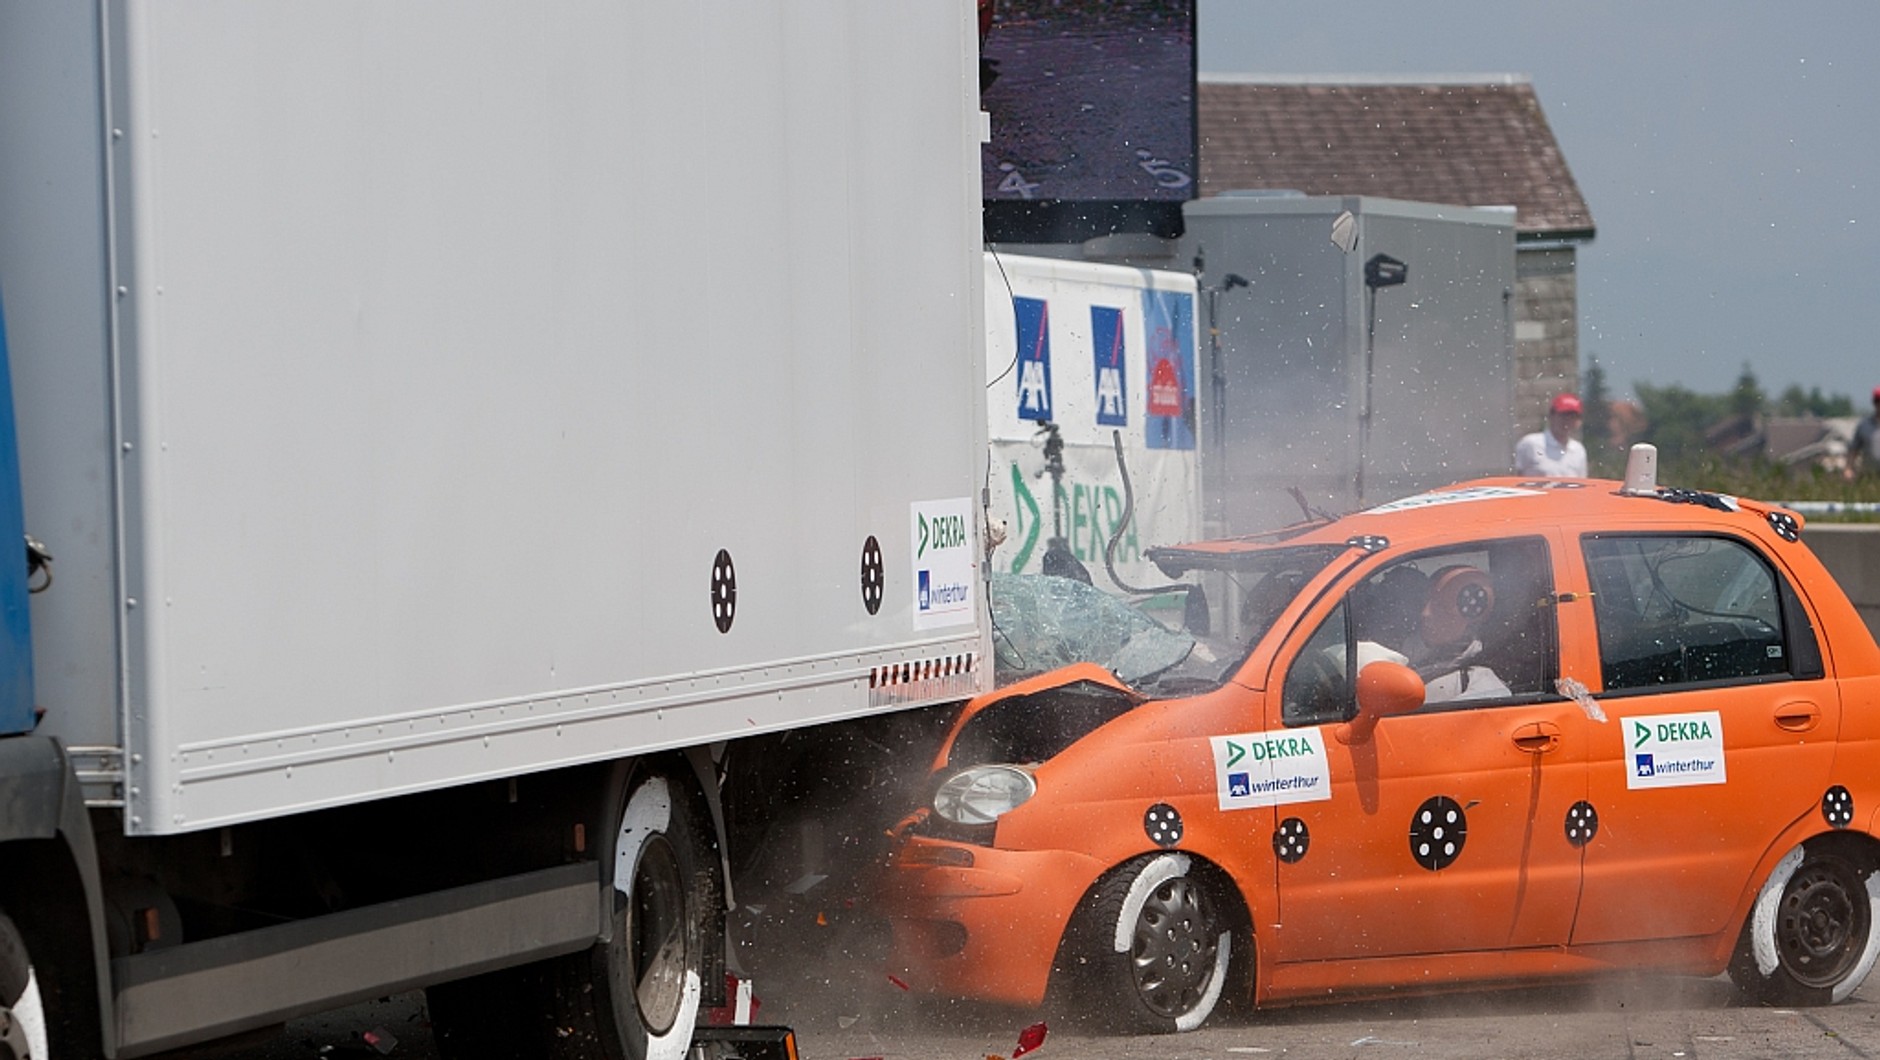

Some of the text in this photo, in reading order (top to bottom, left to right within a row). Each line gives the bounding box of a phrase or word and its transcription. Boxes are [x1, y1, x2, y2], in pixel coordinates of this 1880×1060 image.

[932, 515, 967, 550] DEKRA
[1053, 483, 1141, 563] DEKRA
[1656, 721, 1713, 742] DEKRA
[1252, 737, 1314, 760] DEKRA
[1656, 759, 1714, 774] winterthur
[1252, 775, 1319, 793] winterthur
